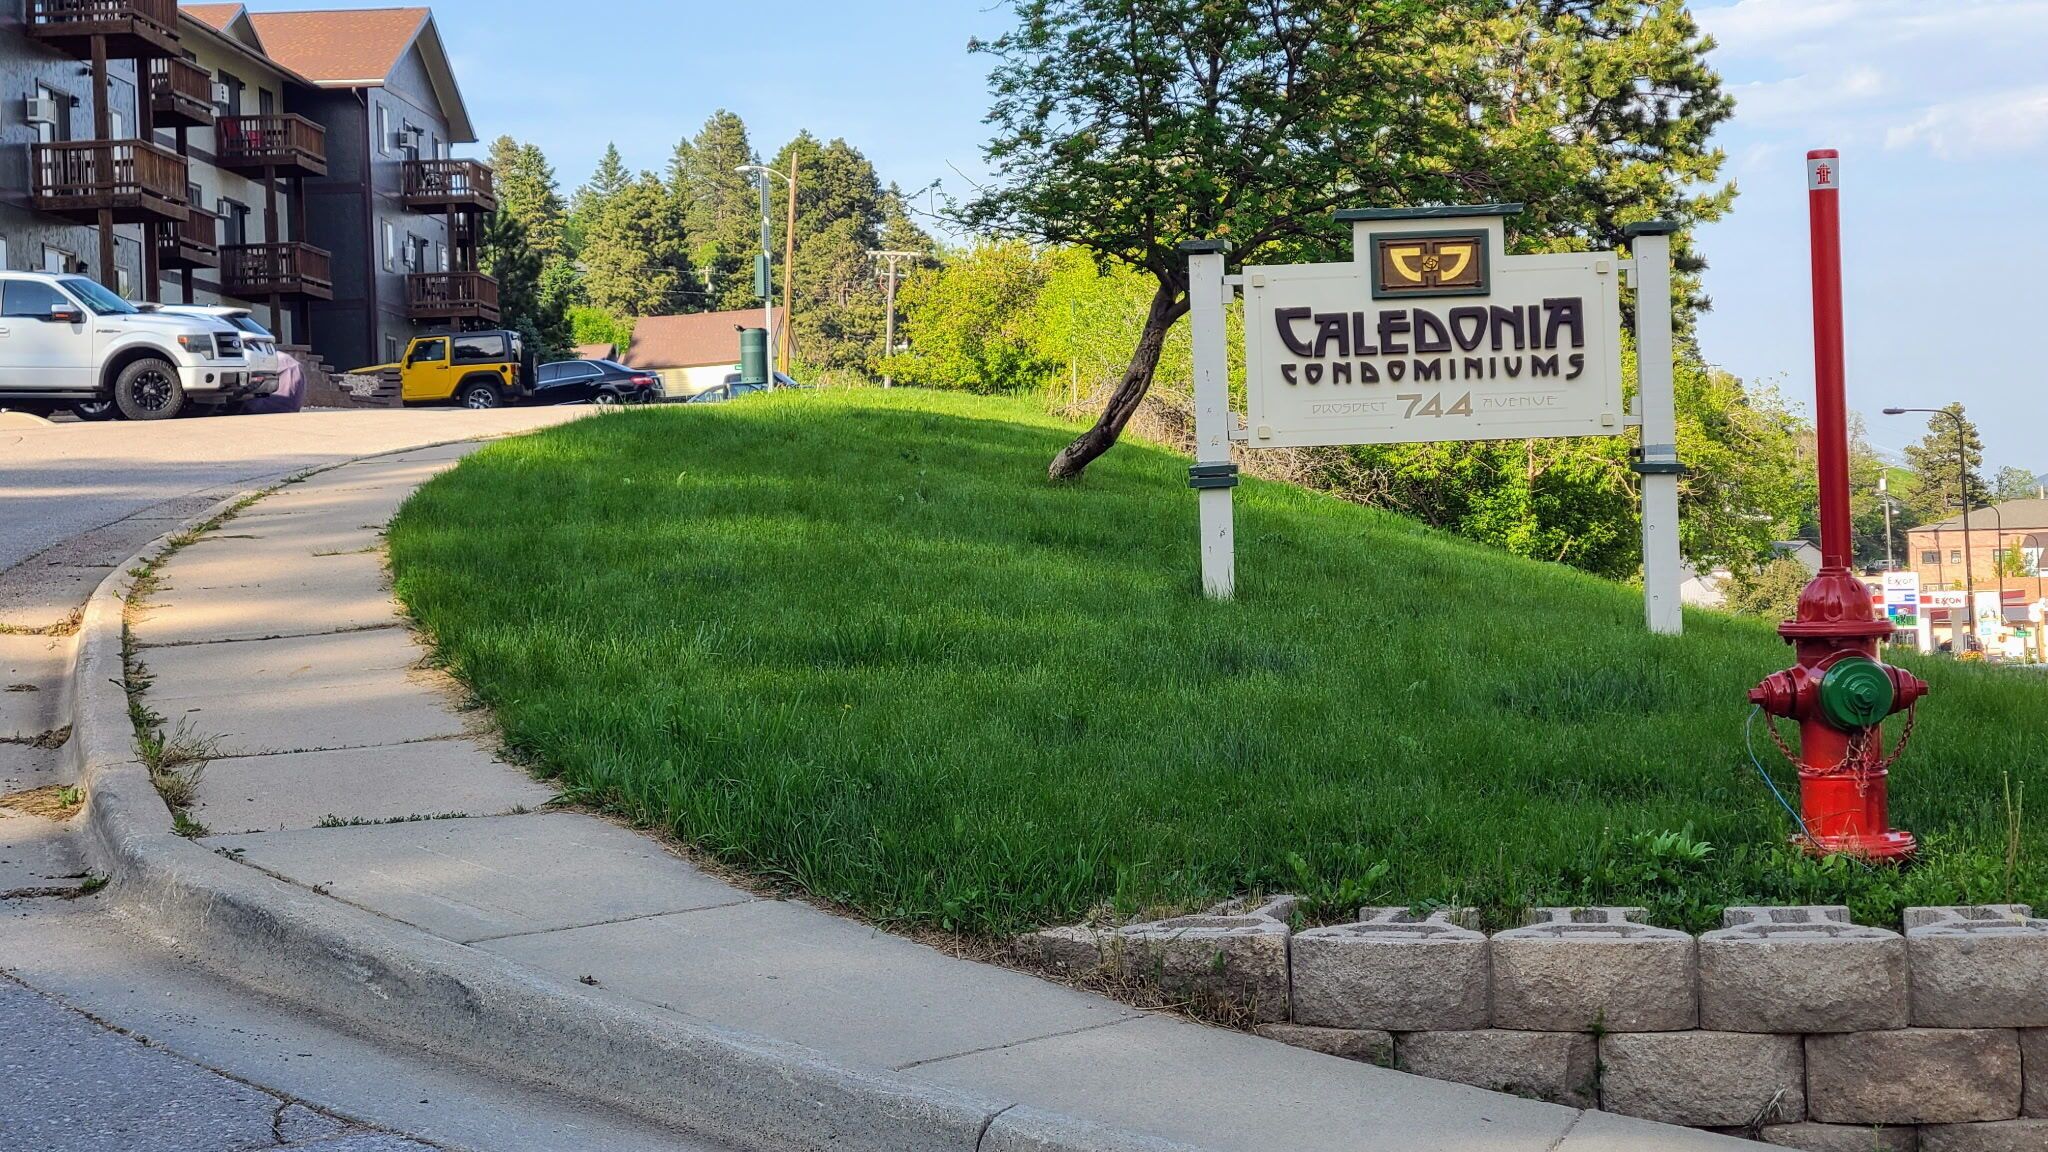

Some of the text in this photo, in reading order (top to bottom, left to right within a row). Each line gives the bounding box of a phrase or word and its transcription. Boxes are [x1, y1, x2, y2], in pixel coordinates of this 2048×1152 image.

[1275, 297, 1584, 358] CALEDONIA
[1281, 353, 1584, 386] CONDOMINIUMS
[1312, 391, 1558, 419] PROSPECT 744 AVENUE
[1935, 596, 1962, 605] EXXON
